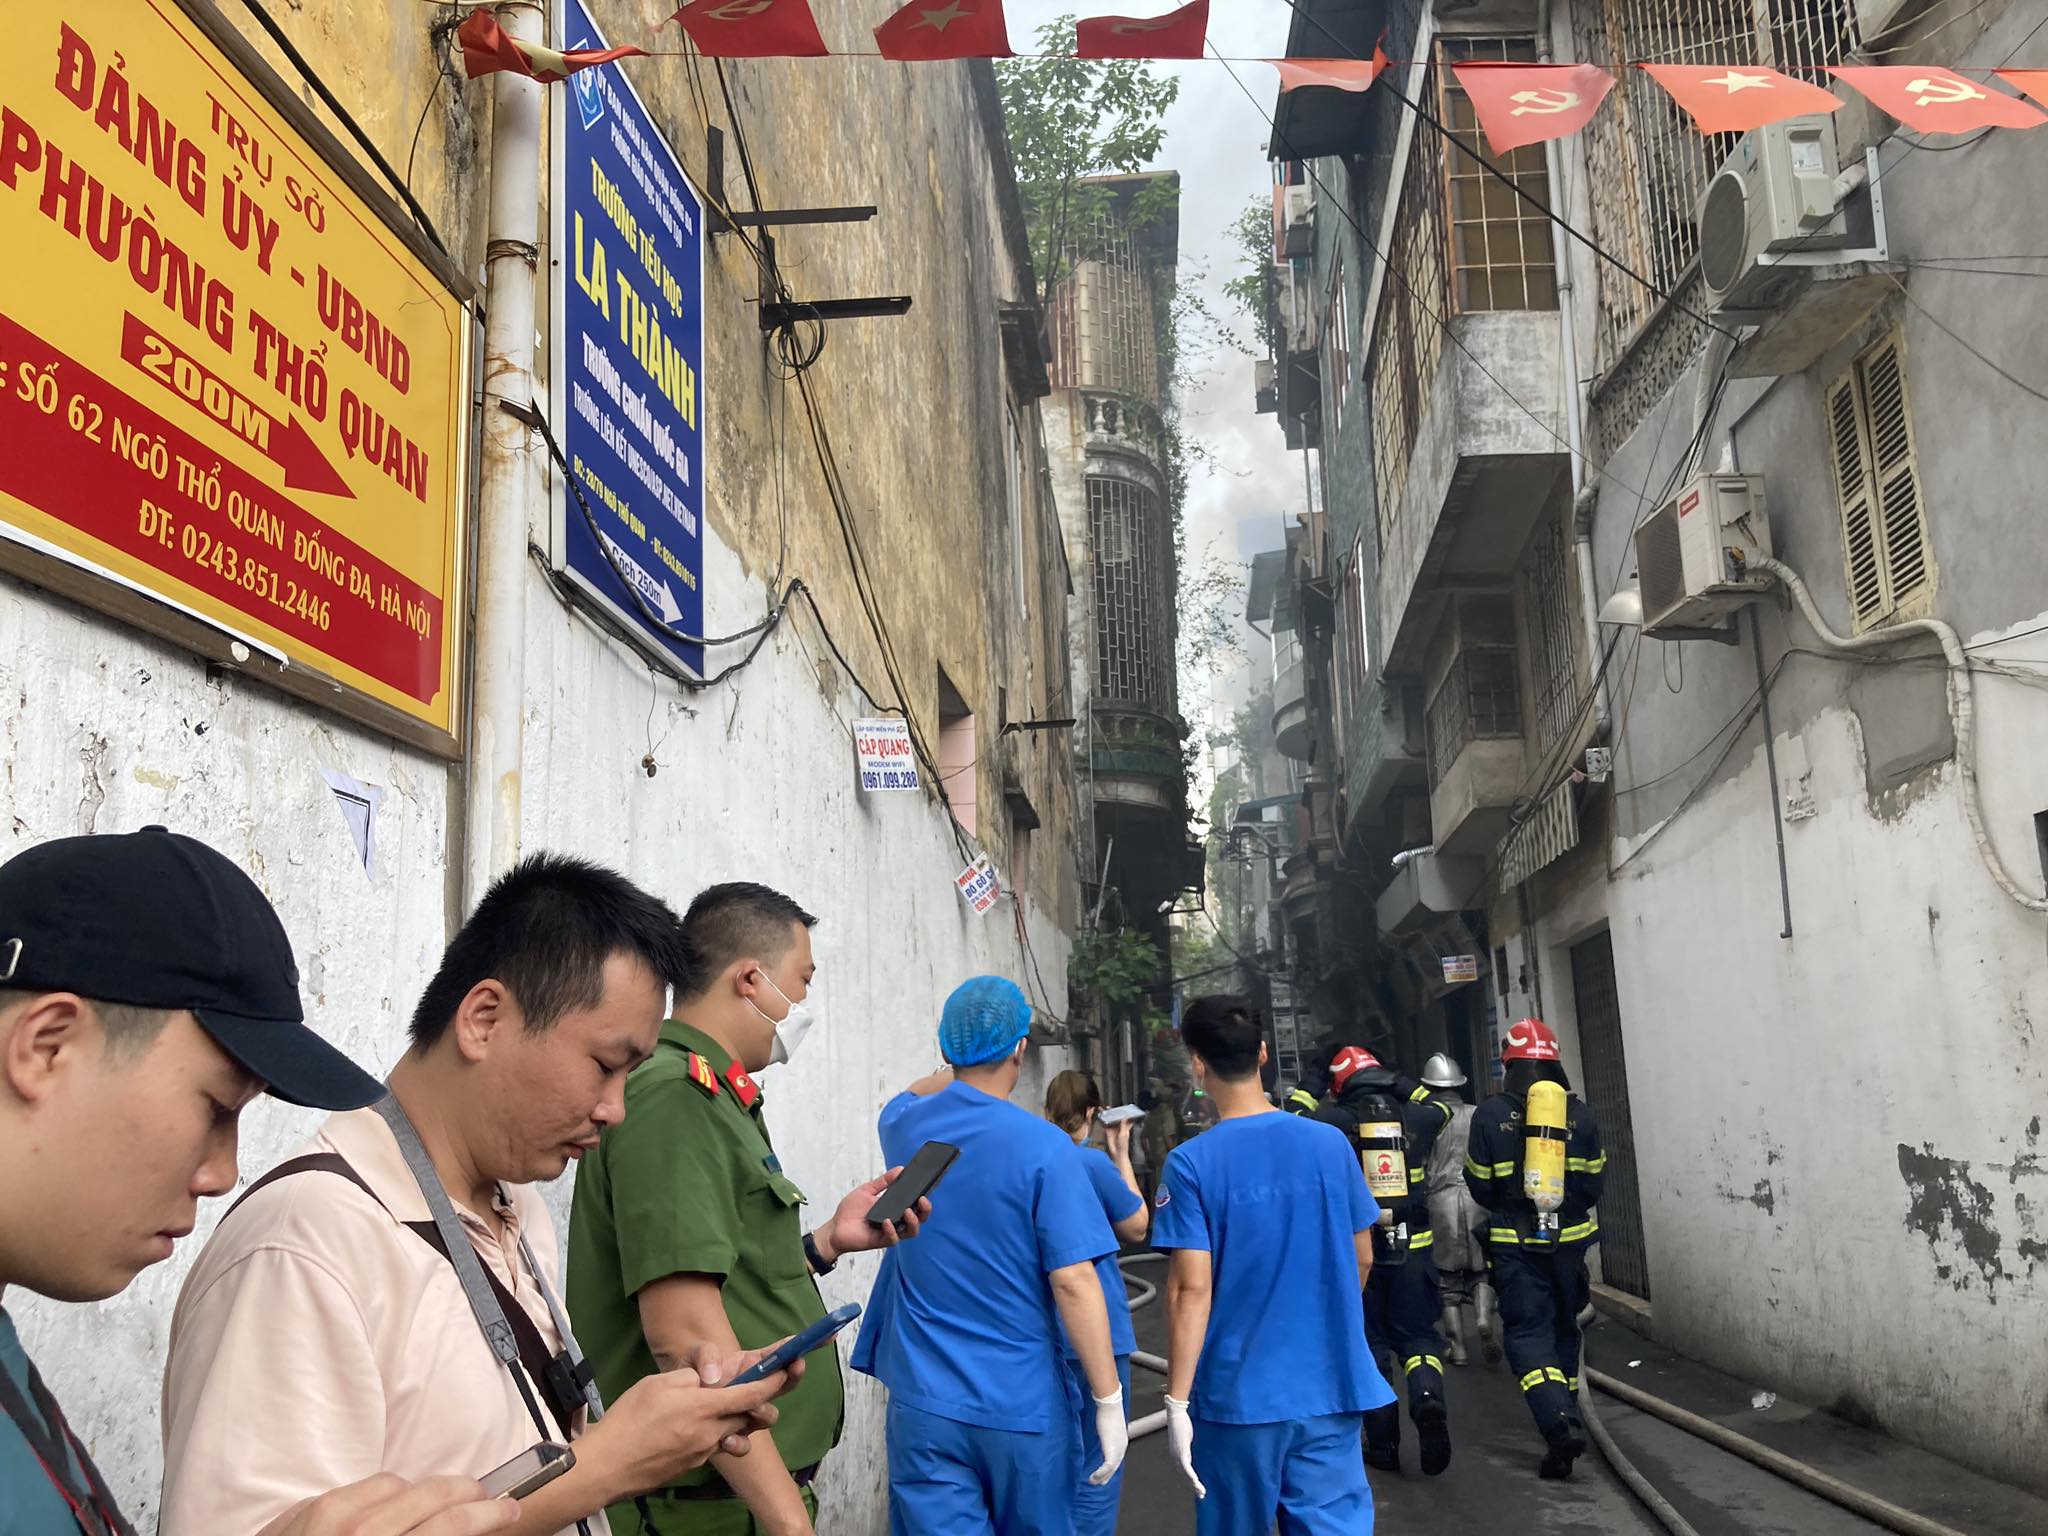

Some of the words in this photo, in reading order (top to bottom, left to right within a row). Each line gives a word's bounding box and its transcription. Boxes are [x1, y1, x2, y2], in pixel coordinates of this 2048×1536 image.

[206, 91, 272, 187] TRỤ
[284, 175, 325, 234] SỞ
[608, 84, 621, 120] BAN
[55, 21, 207, 218] ĐẢNG
[221, 165, 279, 276] ỦY
[291, 266, 305, 288] -
[317, 264, 411, 396] UBND
[591, 157, 636, 253] TRƯỜNG
[639, 228, 660, 287] TIỂU
[663, 265, 682, 318] HỌC
[0, 106, 234, 354] PHƯỜNG
[249, 308, 328, 423] THỔ
[339, 387, 428, 504] QUAN
[575, 210, 609, 321] LA
[617, 269, 694, 431] THÀNH
[140, 334, 270, 454] 200M
[574, 381, 599, 432] TRƯỜNG
[601, 412, 614, 449] LIÊN
[616, 428, 627, 462] KẾT
[583, 331, 620, 406] TRƯỜNG
[653, 420, 674, 469] QUỐC
[676, 447, 689, 487] GIA
[16, 361, 60, 414] SỐ
[68, 394, 104, 444] 62
[112, 417, 168, 480] NGÕ
[176, 461, 221, 511] THỔ
[227, 490, 285, 551] QUAN
[293, 529, 345, 586] ĐỐNG
[349, 565, 375, 610] ĐA,
[380, 584, 402, 623] HÀ
[406, 598, 431, 639] NỘI
[139, 499, 175, 549] ĐT:
[182, 524, 331, 632] 0243.851.2446
[638, 571, 662, 606] 250m
[858, 733, 876, 755] CÁP
[878, 738, 910, 759] QUANG
[862, 771, 918, 789] 0961.099.288
[959, 867, 977, 887] MUA
